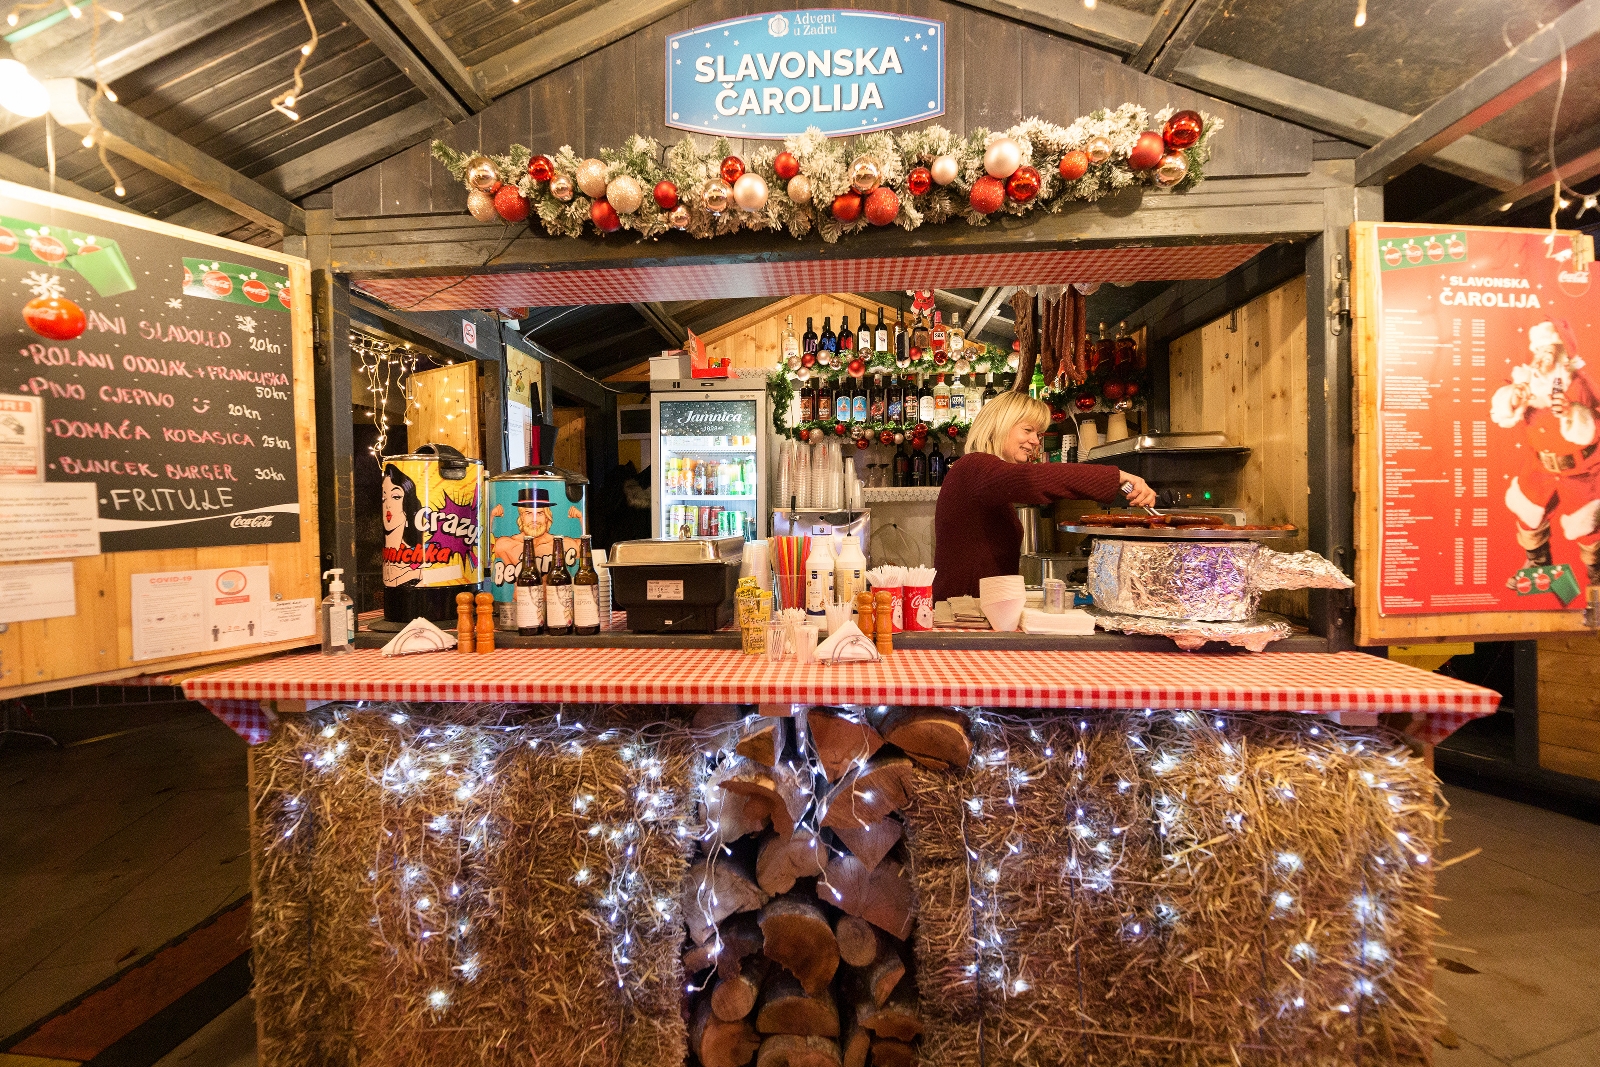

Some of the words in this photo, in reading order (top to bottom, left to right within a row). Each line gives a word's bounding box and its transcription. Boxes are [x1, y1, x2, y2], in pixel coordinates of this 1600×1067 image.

[793, 13, 836, 25] Advent
[793, 27, 800, 36] u
[803, 23, 837, 36] Zadru
[694, 46, 903, 83] SLAVONSKA
[714, 82, 884, 116] ČAROLIJA
[1449, 275, 1530, 289] SLAVONSKA
[1439, 287, 1541, 309] ČAROLIJA
[139, 320, 232, 348] SLADOLED
[122, 354, 194, 378] ODOJAK
[28, 377, 86, 400] PIVO
[678, 410, 742, 424] Jamnica
[51, 419, 151, 440] DOMAĆA
[162, 427, 255, 447] KOBASICA
[165, 463, 238, 481] BURGER
[110, 487, 234, 511] FRITULE
[230, 515, 274, 528] Coca-Cola
[149, 575, 193, 584] COVID-19
